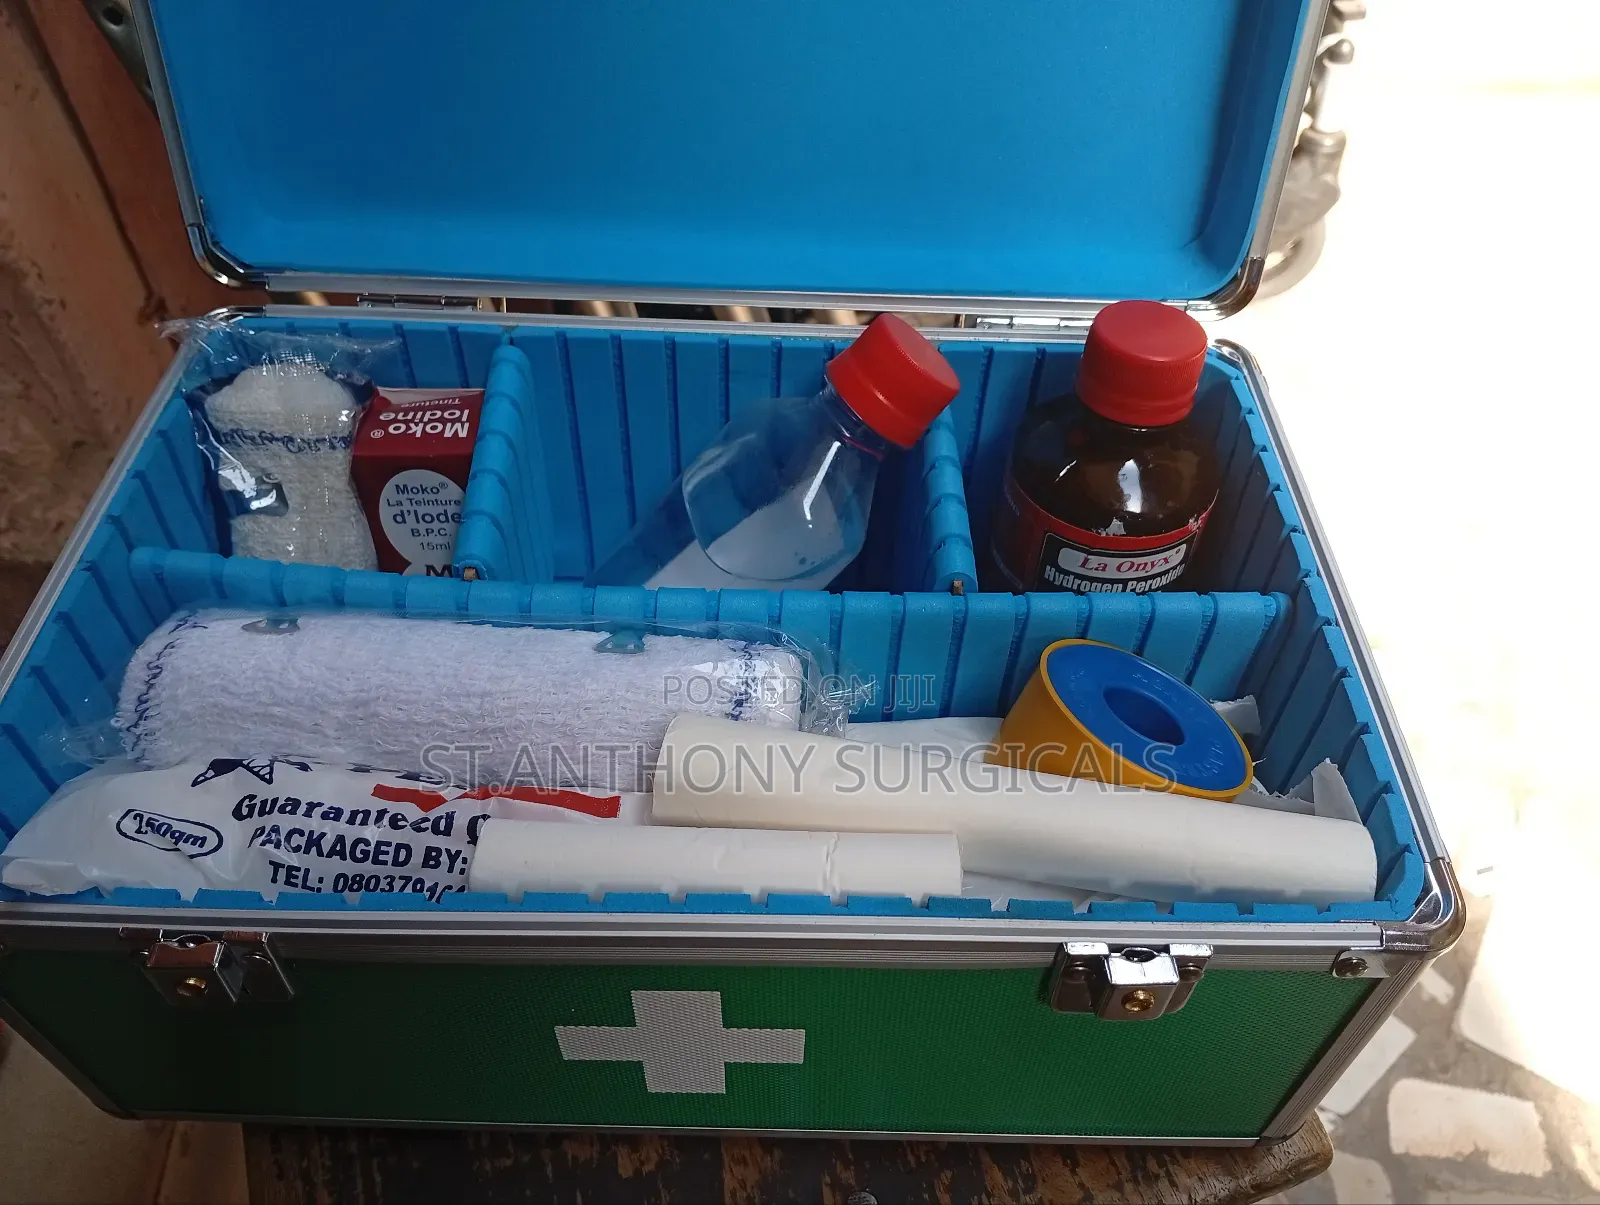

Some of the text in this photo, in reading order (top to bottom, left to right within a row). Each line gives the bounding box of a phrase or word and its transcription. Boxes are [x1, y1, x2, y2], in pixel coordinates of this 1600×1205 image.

[401, 398, 461, 408] Tincture
[379, 409, 470, 422] Iodine
[386, 497, 461, 507] La Teinture
[411, 527, 452, 537] B.P.C.
[1078, 555, 1108, 572] La
[1043, 564, 1122, 593] Hydrogen
[1126, 563, 1185, 592] Peroxide
[231, 793, 457, 837] Guaranteed
[247, 824, 468, 876] PACKAGED BY:
[268, 860, 324, 894] TEL:
